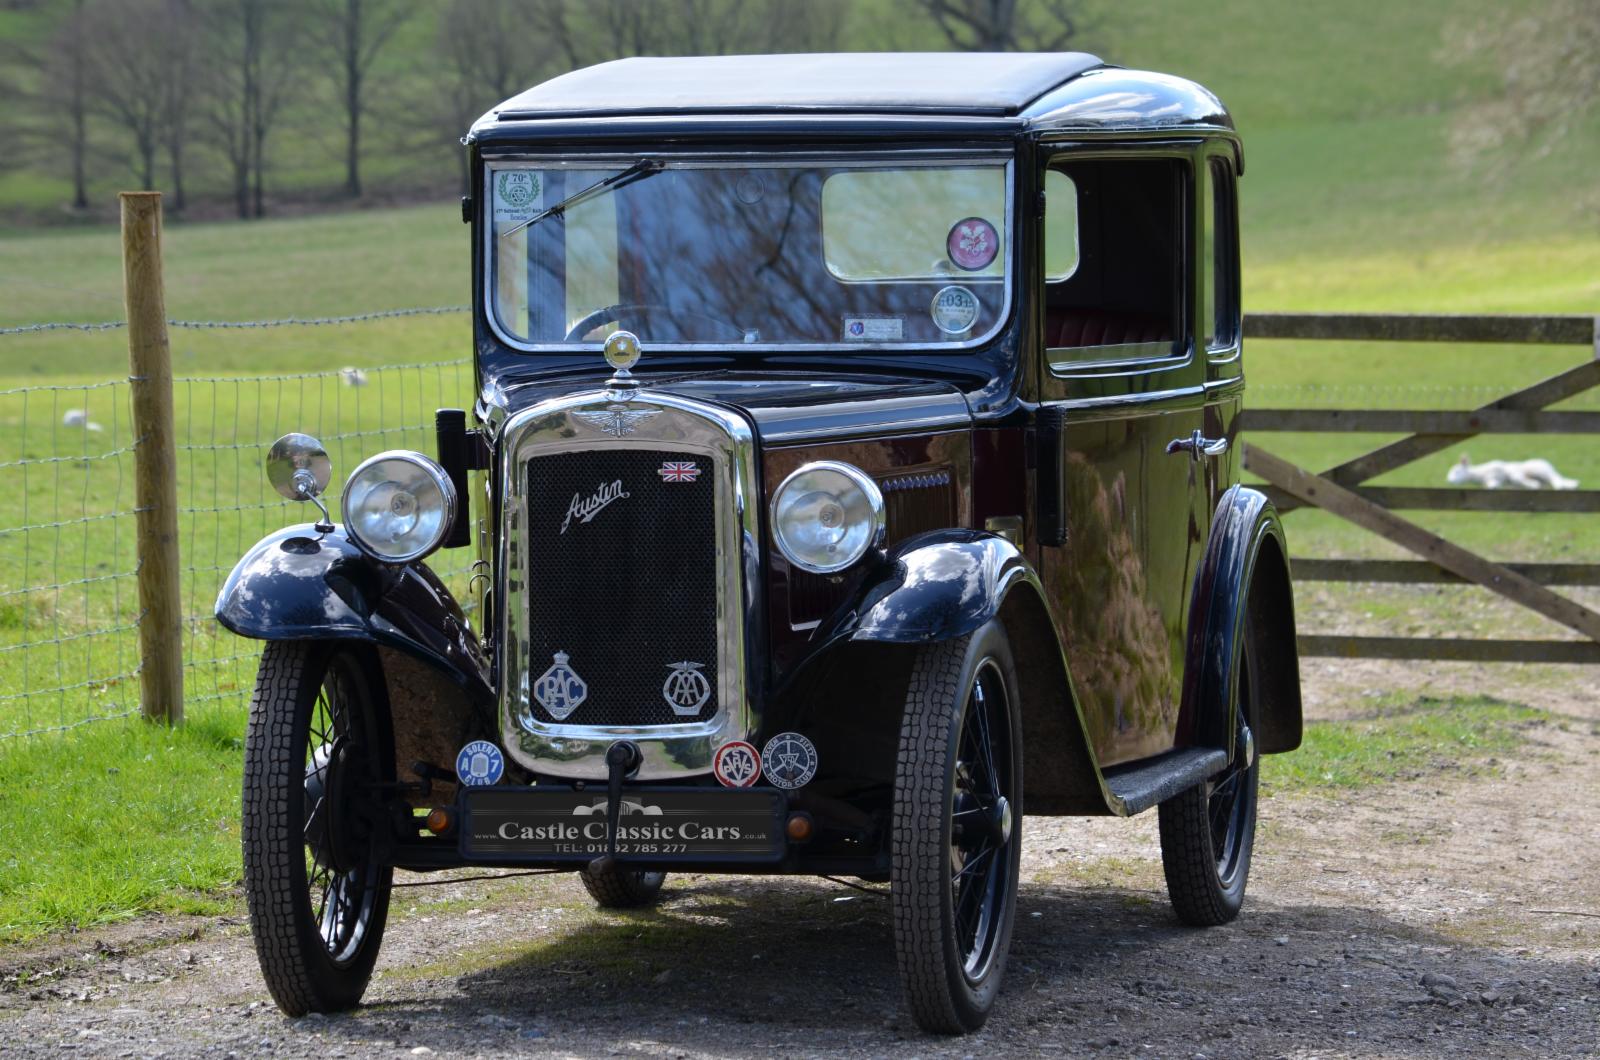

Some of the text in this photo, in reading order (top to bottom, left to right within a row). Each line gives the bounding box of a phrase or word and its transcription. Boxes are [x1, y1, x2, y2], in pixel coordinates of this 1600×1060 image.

[560, 479, 629, 534] Austin
[465, 743, 498, 757] SOLENT
[461, 757, 500, 773] A 7
[464, 774, 491, 786] CLUB
[768, 770, 812, 788] MOTOR CLUB
[498, 822, 579, 840] Castle
[678, 822, 741, 840] Cars
[553, 843, 583, 853] TEL:
[633, 843, 658, 853] 785
[662, 843, 687, 853] 277
